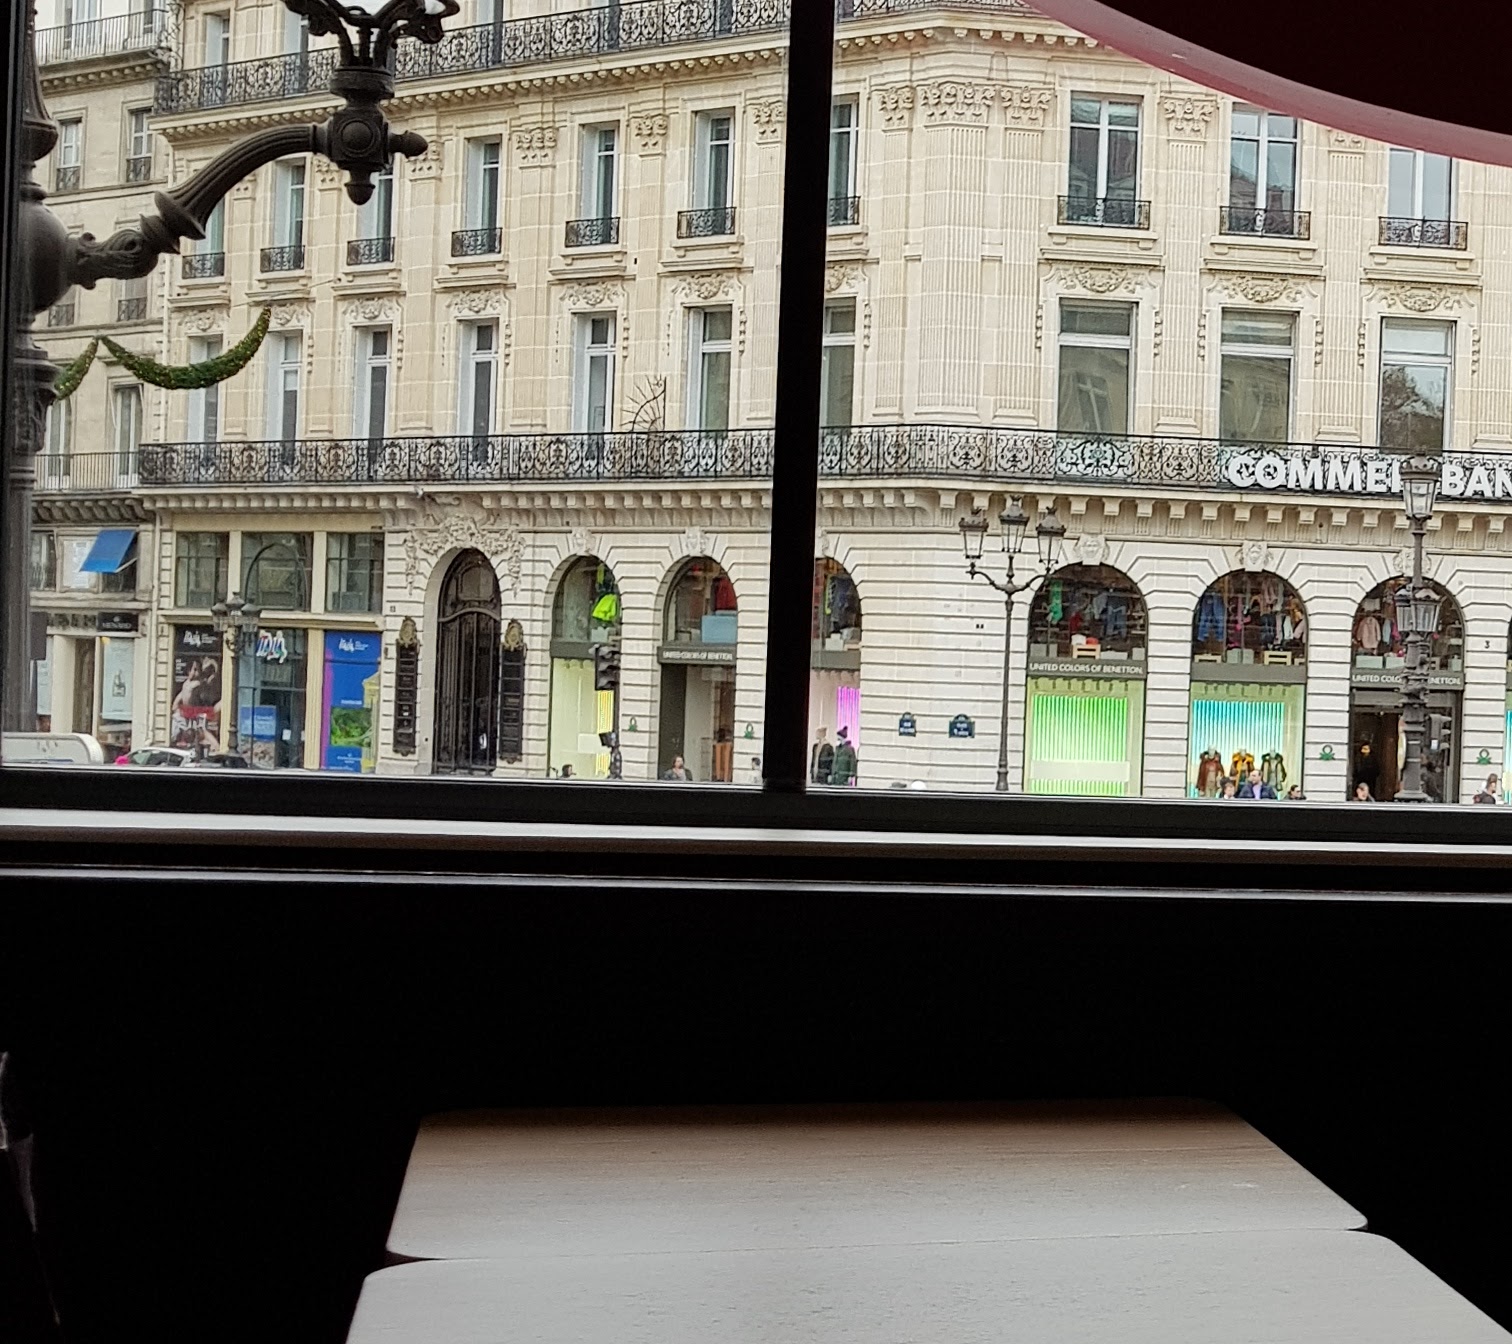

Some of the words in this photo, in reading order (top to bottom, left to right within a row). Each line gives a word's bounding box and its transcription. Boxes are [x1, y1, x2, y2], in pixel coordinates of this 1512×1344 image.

[1484, 640, 1490, 649] 3
[1029, 662, 1058, 671] UNITED
[1059, 663, 1090, 672] COLORS
[1091, 664, 1101, 672] OF
[1352, 674, 1379, 682] UNITED
